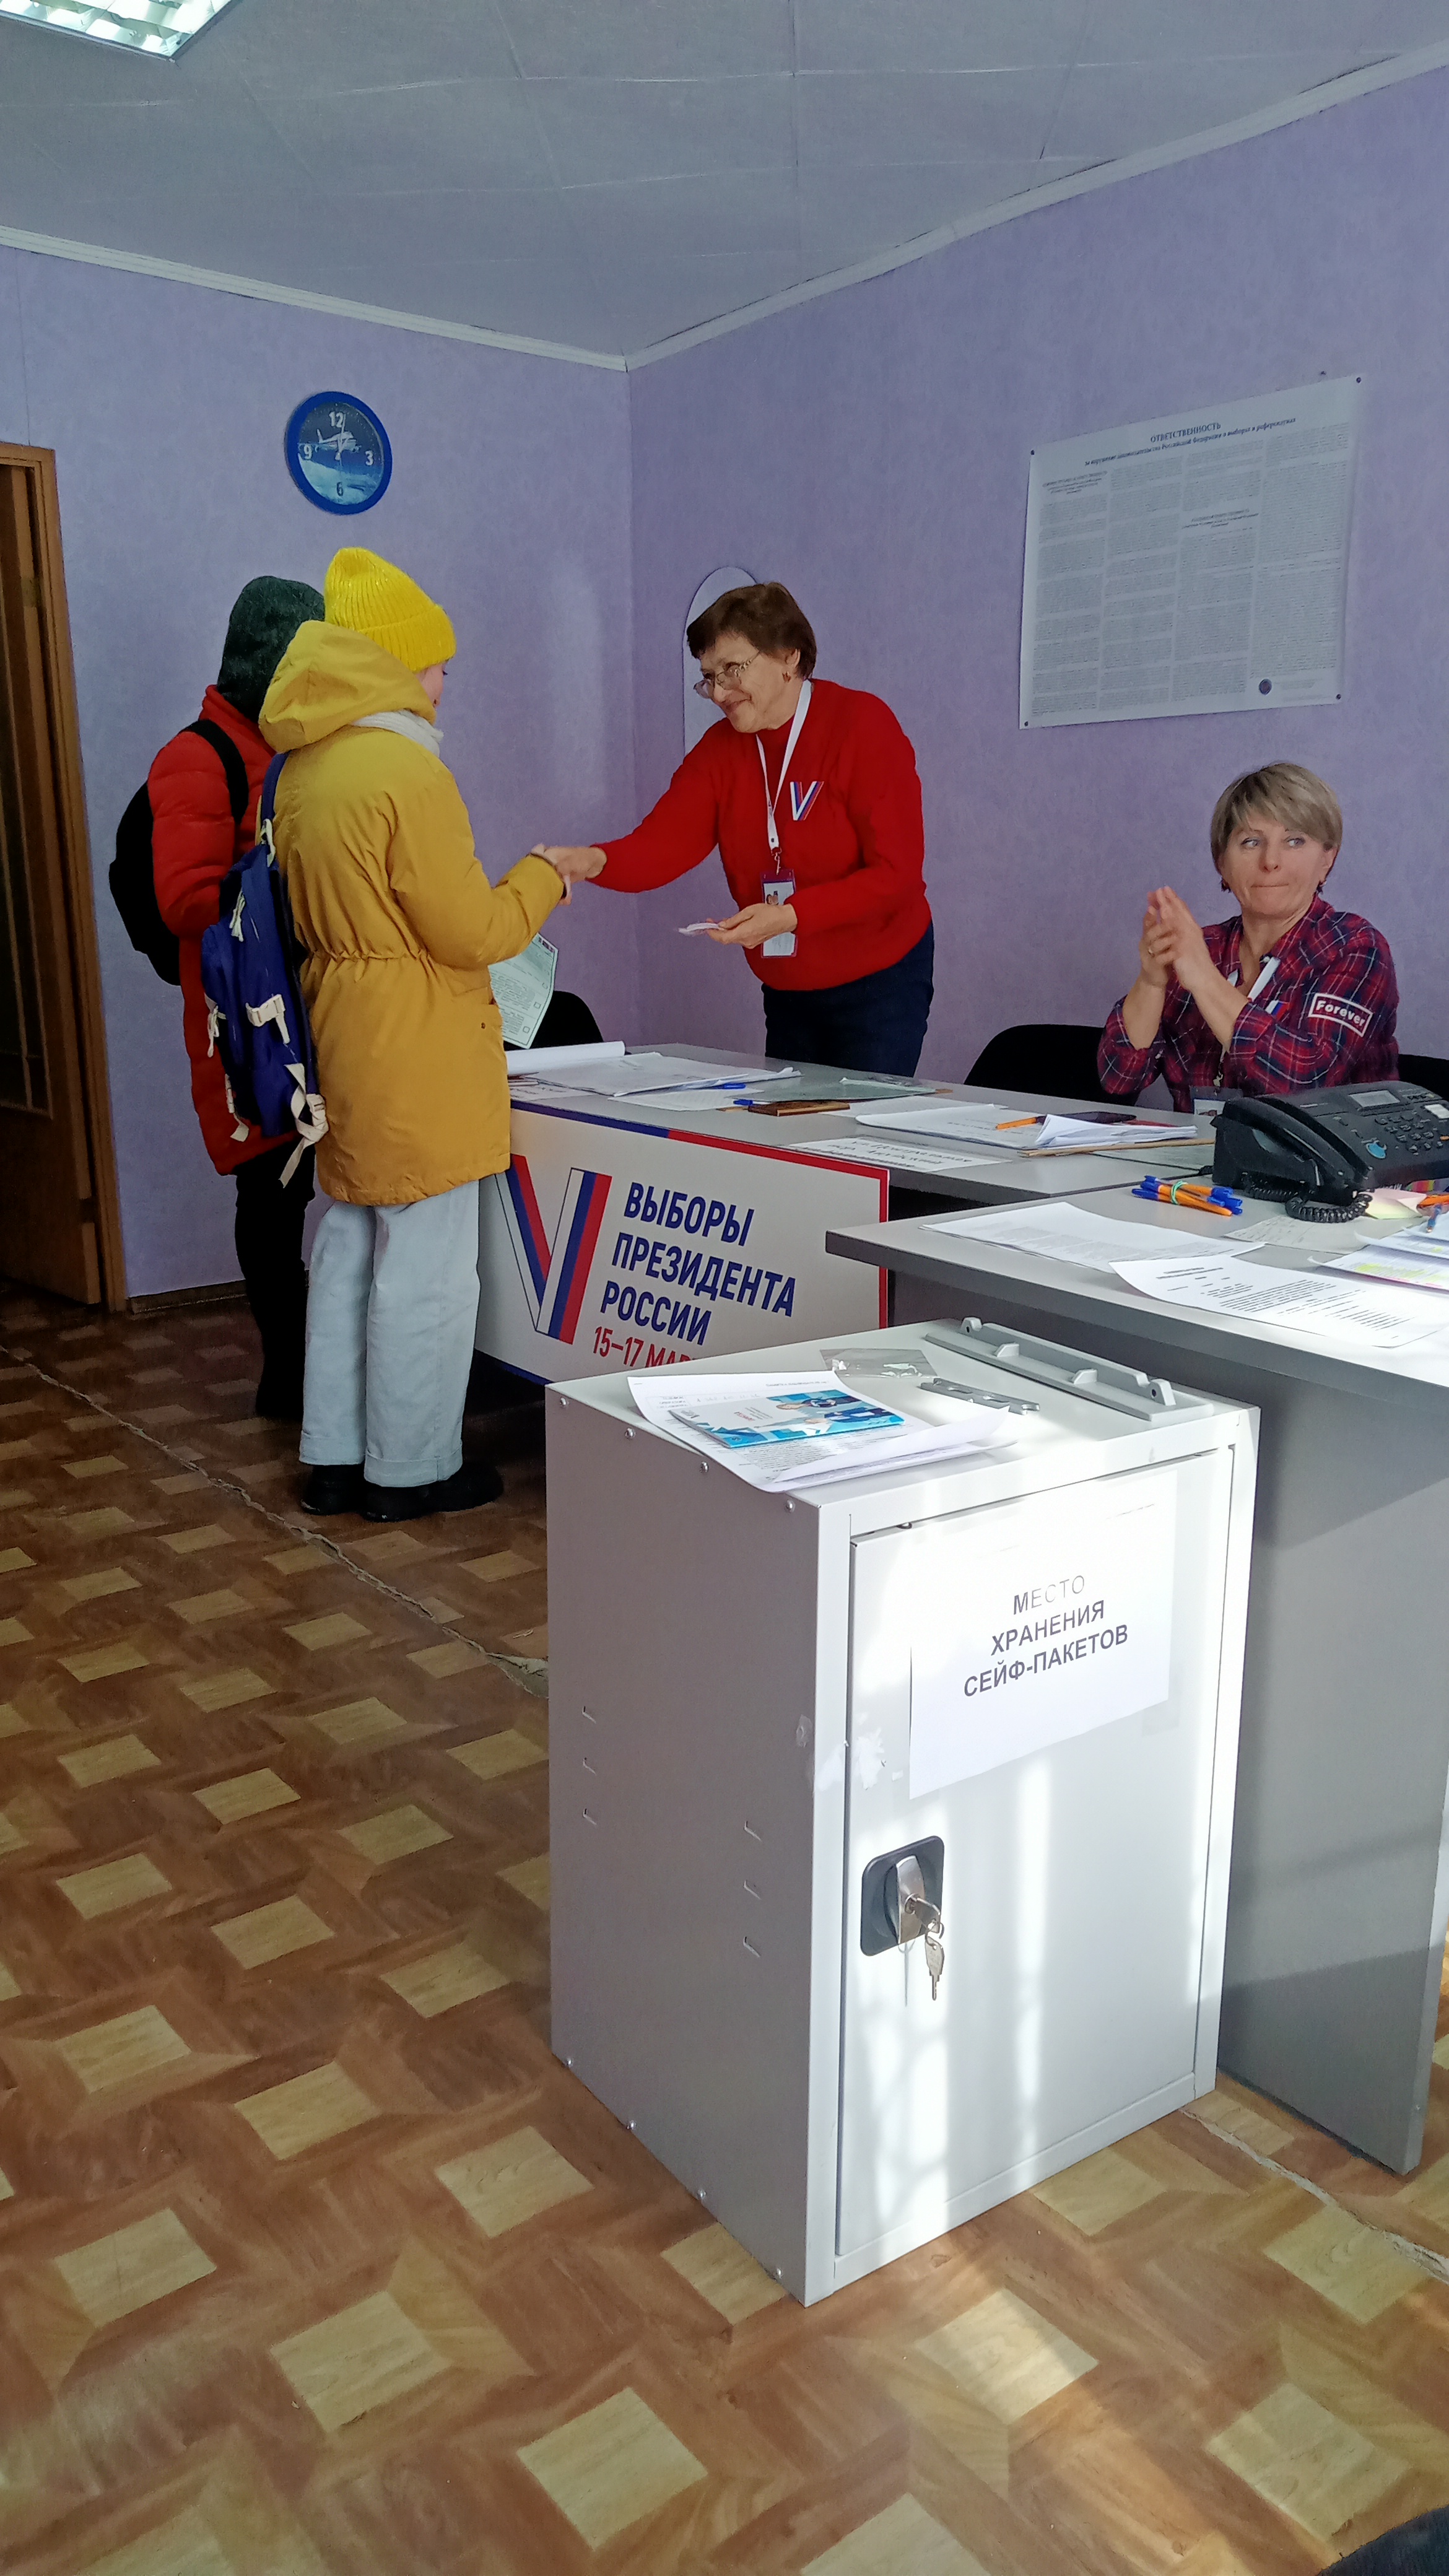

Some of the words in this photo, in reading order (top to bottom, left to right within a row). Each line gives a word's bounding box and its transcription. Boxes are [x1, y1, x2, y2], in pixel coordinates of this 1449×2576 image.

[328, 411, 344, 428] 12
[1150, 422, 1222, 443] ОТВЕТСТВЕННОСТЬ
[303, 443, 313, 460] 9
[365, 450, 375, 466] 3
[336, 481, 344, 497] 6
[1315, 999, 1366, 1027] Forever
[624, 1182, 754, 1247] ВЫБОРЫ
[612, 1232, 796, 1317] ПРЕЗИДЕНТА
[600, 1280, 712, 1346] РОССИИ
[1013, 1575, 1086, 1616] МЕСТО
[990, 1599, 1105, 1656] ХРАНЕНИЯ
[963, 1624, 1129, 1697] СЕЙФ-ПАКЕТОВ
